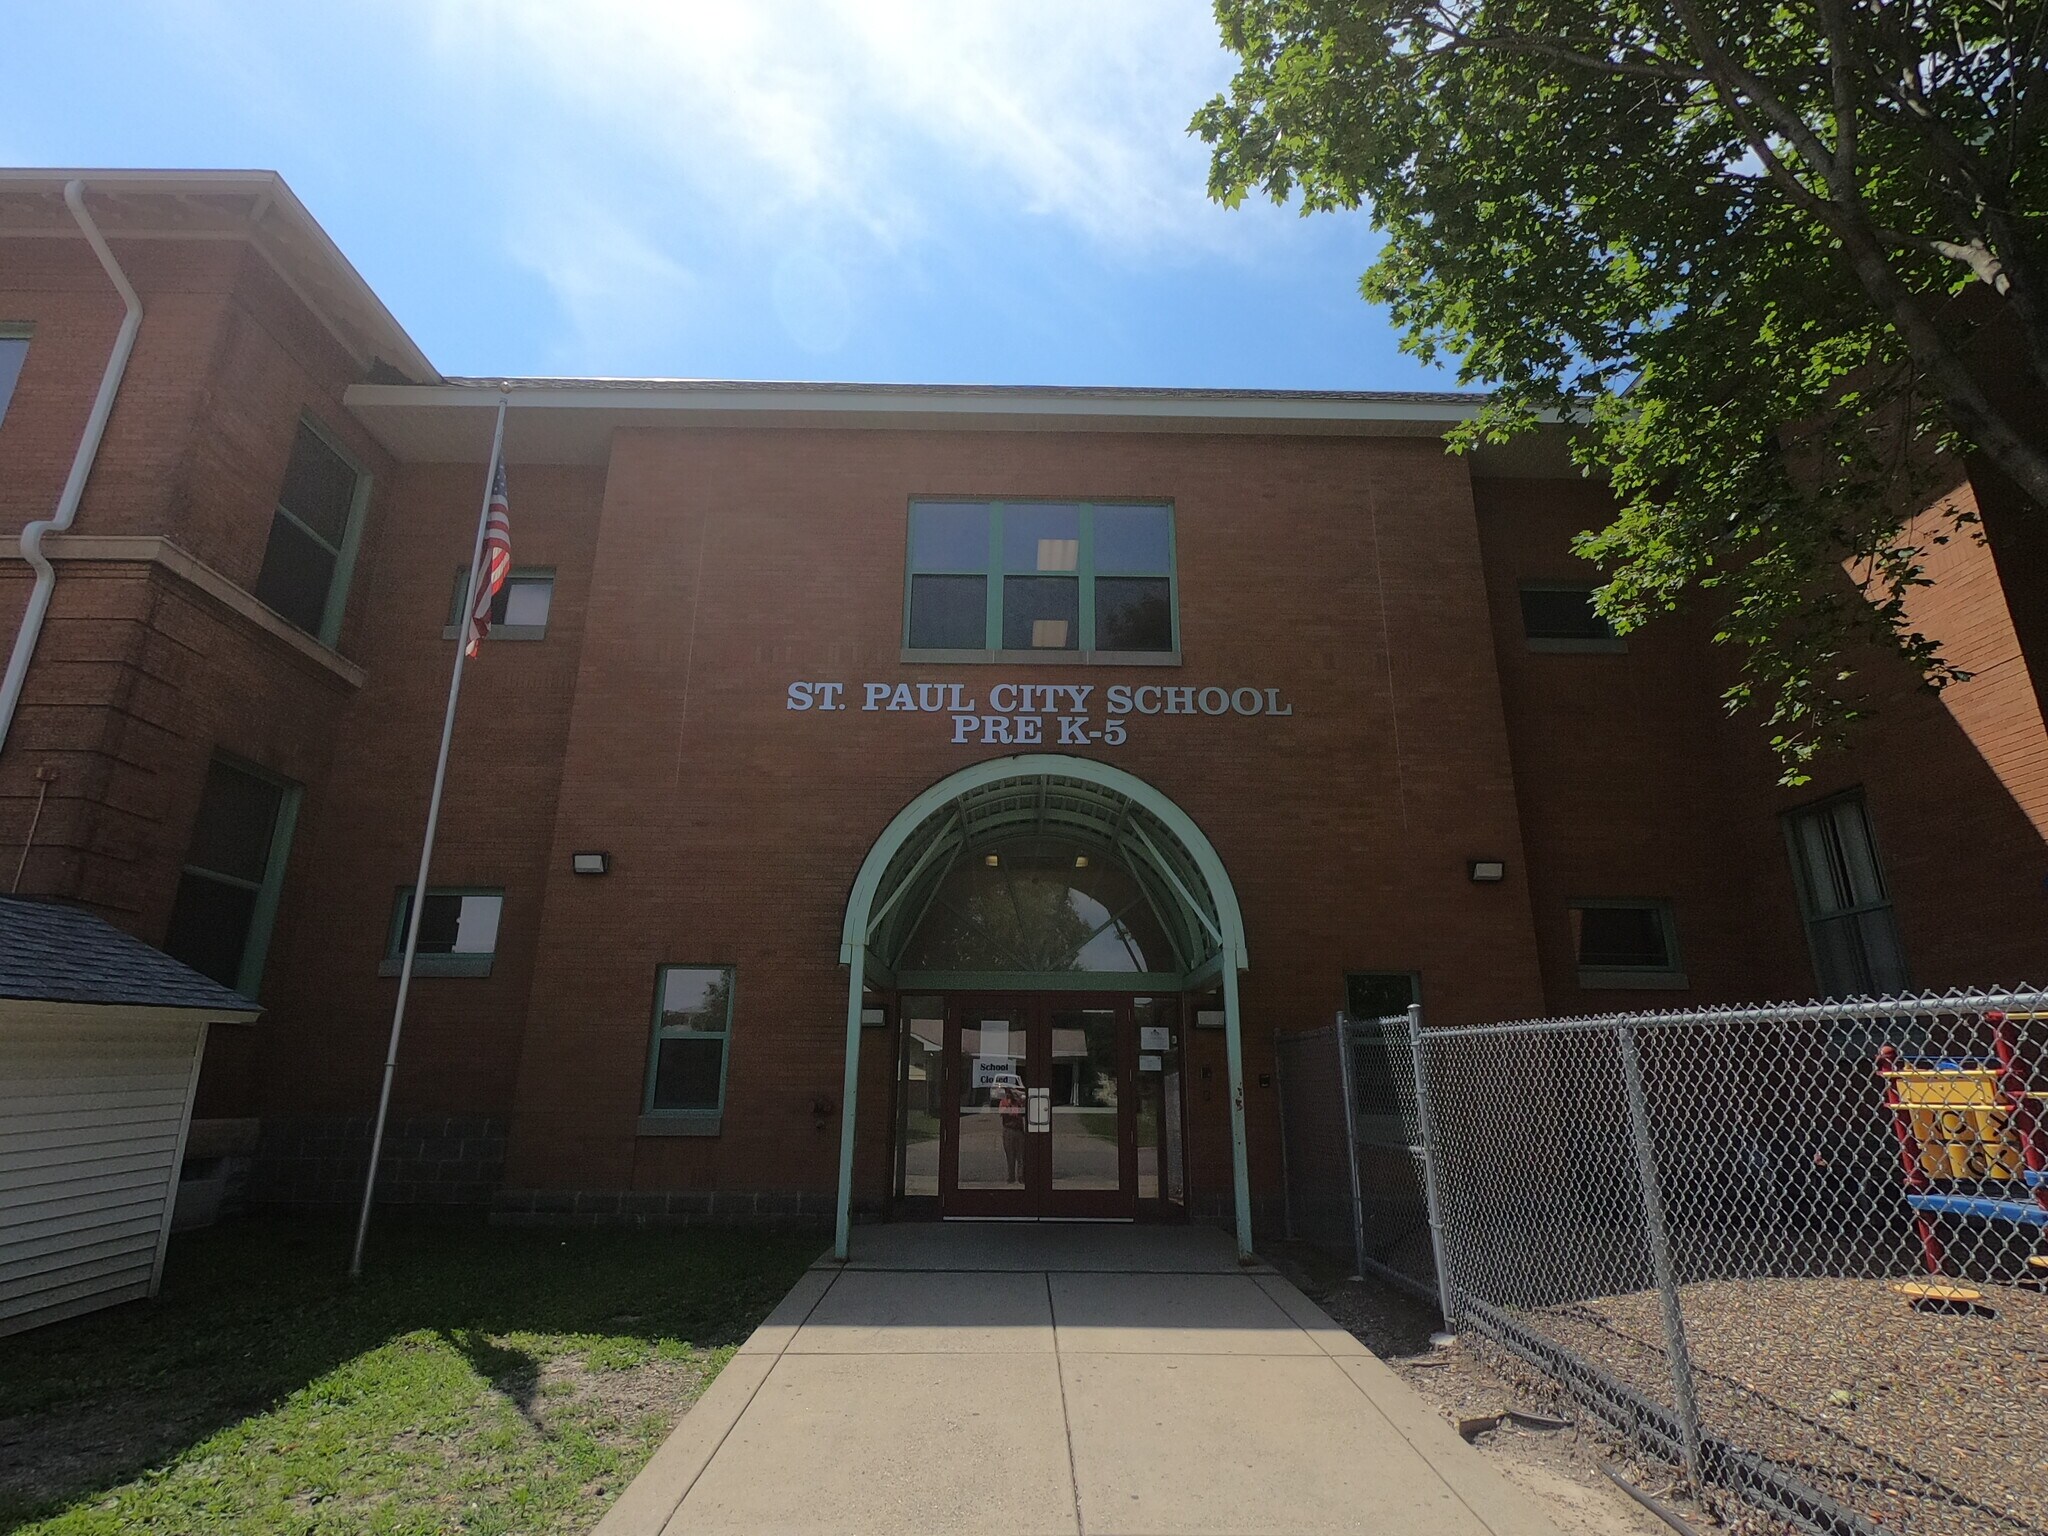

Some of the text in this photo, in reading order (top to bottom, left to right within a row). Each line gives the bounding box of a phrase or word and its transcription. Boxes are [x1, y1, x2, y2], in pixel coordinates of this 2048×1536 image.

[786, 682, 1293, 716] ST. PAUL CITY SCHOOL
[951, 715, 1127, 746] PRE K-5
[980, 1063, 1009, 1071] School
